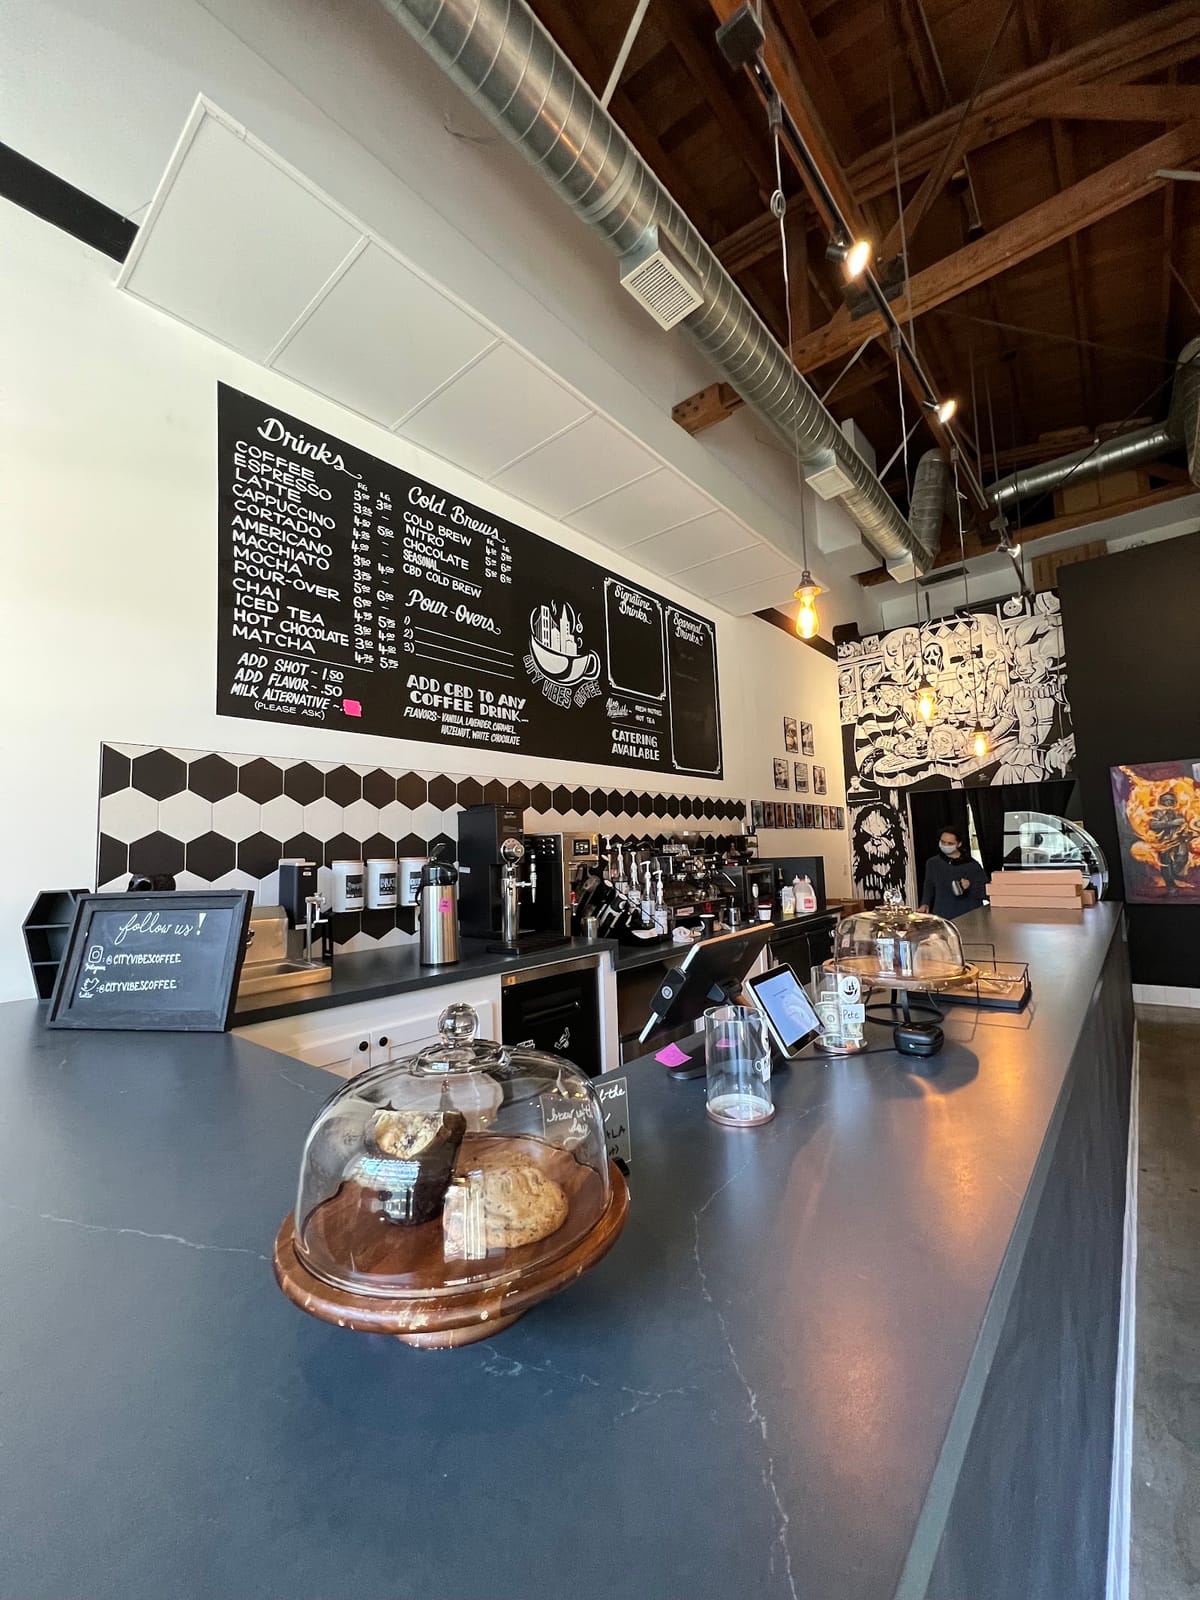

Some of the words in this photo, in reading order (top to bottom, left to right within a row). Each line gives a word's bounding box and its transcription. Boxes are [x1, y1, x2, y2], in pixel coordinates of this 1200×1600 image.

[235, 441, 315, 481] COFFEE
[257, 418, 362, 480] Drinks
[234, 453, 332, 500] ESPRESSO
[236, 468, 302, 503] LATTE
[232, 484, 336, 530] CAPPUCCINO
[234, 500, 321, 538] CORTADO
[408, 486, 447, 517] Cold
[450, 506, 506, 543] Brews
[231, 515, 333, 557] AMERICANO
[403, 512, 434, 531] COLD
[438, 525, 472, 546] BREW
[406, 524, 444, 547] NITRO
[233, 529, 330, 571] MACCHIATO
[234, 545, 303, 577] MOCHA
[403, 538, 469, 570] CHOCOLATE
[403, 549, 440, 572] SEASONAL
[232, 578, 280, 601] CHAI
[235, 560, 341, 602] POUR-OVER
[403, 563, 422, 577] CBD
[426, 572, 449, 586] COLD
[452, 580, 482, 598] BREW
[236, 592, 279, 613] ICED
[287, 606, 325, 626] TEA
[405, 589, 501, 636] Pour-Overs
[614, 584, 652, 612] Signature
[619, 601, 652, 625] Drinks
[232, 624, 316, 654] MATCHA
[234, 608, 273, 627] HOT
[280, 620, 349, 646] CHOCOLATE
[403, 628, 413, 639] 2)
[404, 642, 415, 653] 3)
[234, 668, 263, 682] ADD
[267, 673, 309, 692] FLAVOR
[320, 685, 343, 696] .50
[237, 653, 268, 668] ADD
[274, 659, 310, 675] SHOT
[322, 668, 344, 682] 1.50
[522, 654, 544, 684] CITY
[542, 680, 572, 710] VIBES
[230, 683, 259, 698] MILK
[262, 688, 331, 710] ALTERNATIVE
[407, 674, 440, 692] ADD
[444, 683, 473, 698] CBD
[478, 689, 494, 703] TO
[499, 694, 526, 710] ANY
[410, 690, 474, 713] COFFEE
[254, 699, 297, 714] (PLEASE
[301, 709, 325, 720] ASK)
[611, 728, 658, 748] CATERING
[611, 742, 660, 761] AVAILABLE
[114, 912, 172, 946] follow
[843, 1009, 860, 1020] Pete
